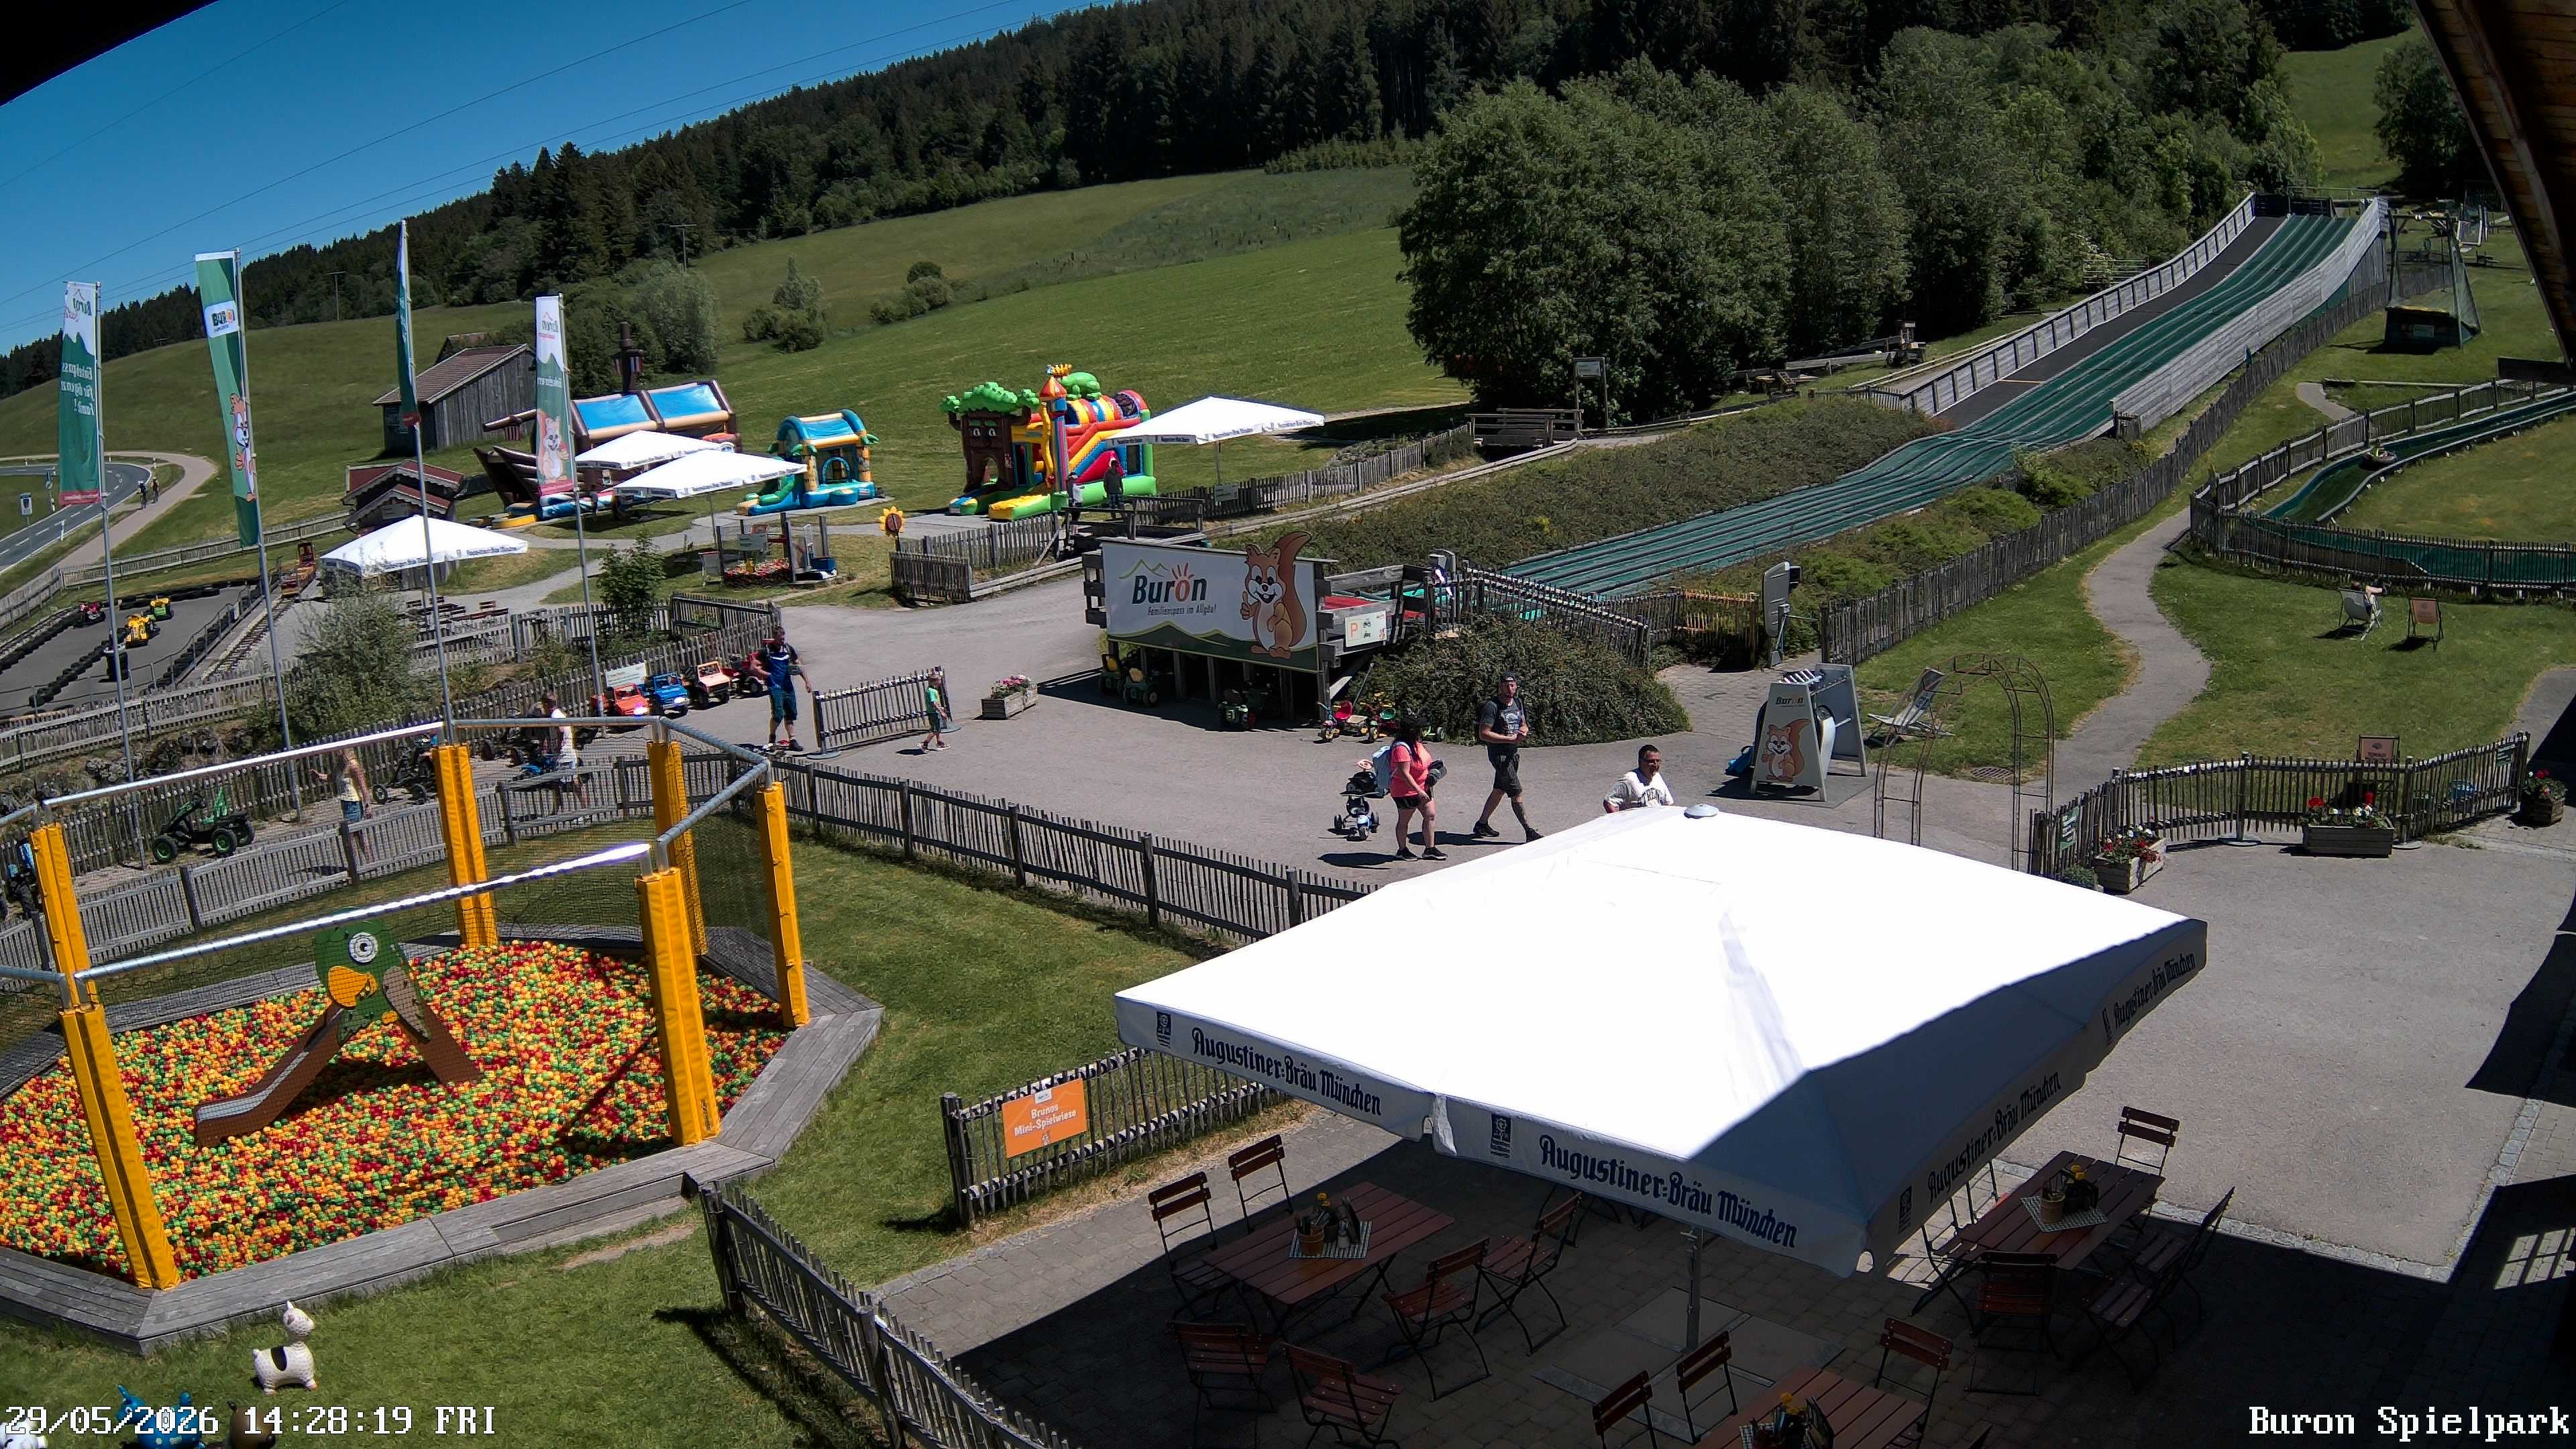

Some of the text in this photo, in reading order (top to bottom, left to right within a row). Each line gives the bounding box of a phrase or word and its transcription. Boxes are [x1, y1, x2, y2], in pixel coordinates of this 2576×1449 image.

[1132, 575, 1208, 604] Buron
[1350, 623, 1358, 638] P
[1320, 1069, 1382, 1116] München
[2019, 1071, 2061, 1121] München
[1014, 1110, 1077, 1136] Mini-Spielwiese
[1030, 1103, 1059, 1119] Brunos
[1717, 1189, 1798, 1248] München
